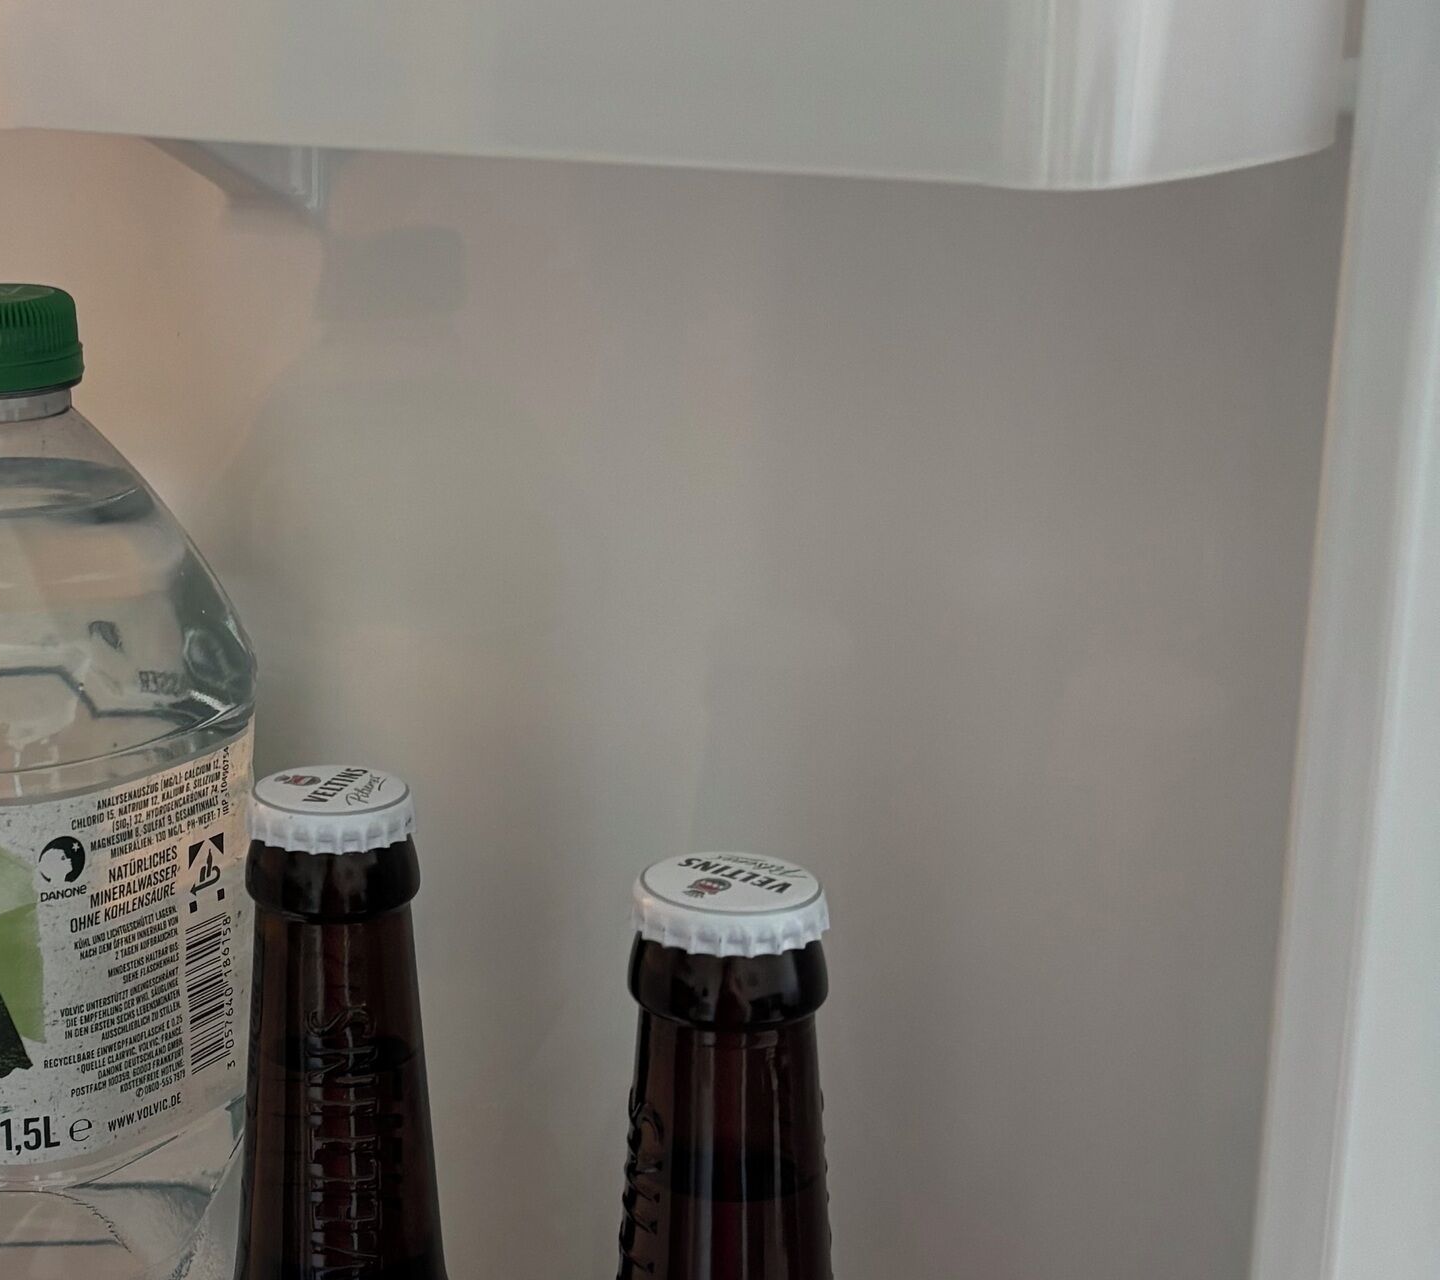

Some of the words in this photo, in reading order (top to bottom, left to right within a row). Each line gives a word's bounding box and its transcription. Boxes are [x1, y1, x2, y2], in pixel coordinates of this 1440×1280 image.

[302, 768, 368, 803] VELTINS
[71, 812, 104, 831] CHLORID
[118, 800, 149, 816] NATRIUM
[90, 829, 133, 852] MAGNESIUM
[108, 845, 178, 883] NATÜRLICHES
[677, 857, 793, 894] VELTINS
[70, 911, 101, 933] OHNE
[104, 881, 176, 923] KOHLENSÄURE
[60, 1003, 85, 1018] VOLVIC
[66, 1016, 79, 1028] DIE
[43, 1051, 96, 1069] RECYCELBARE
[97, 1063, 123, 1080] DANONE
[227, 1060, 236, 1070] 3
[70, 1080, 107, 1098] POSTFACH
[107, 1091, 182, 1132] WWW.VOLVIC.DE
[0, 1116, 60, 1155] 1,5L
